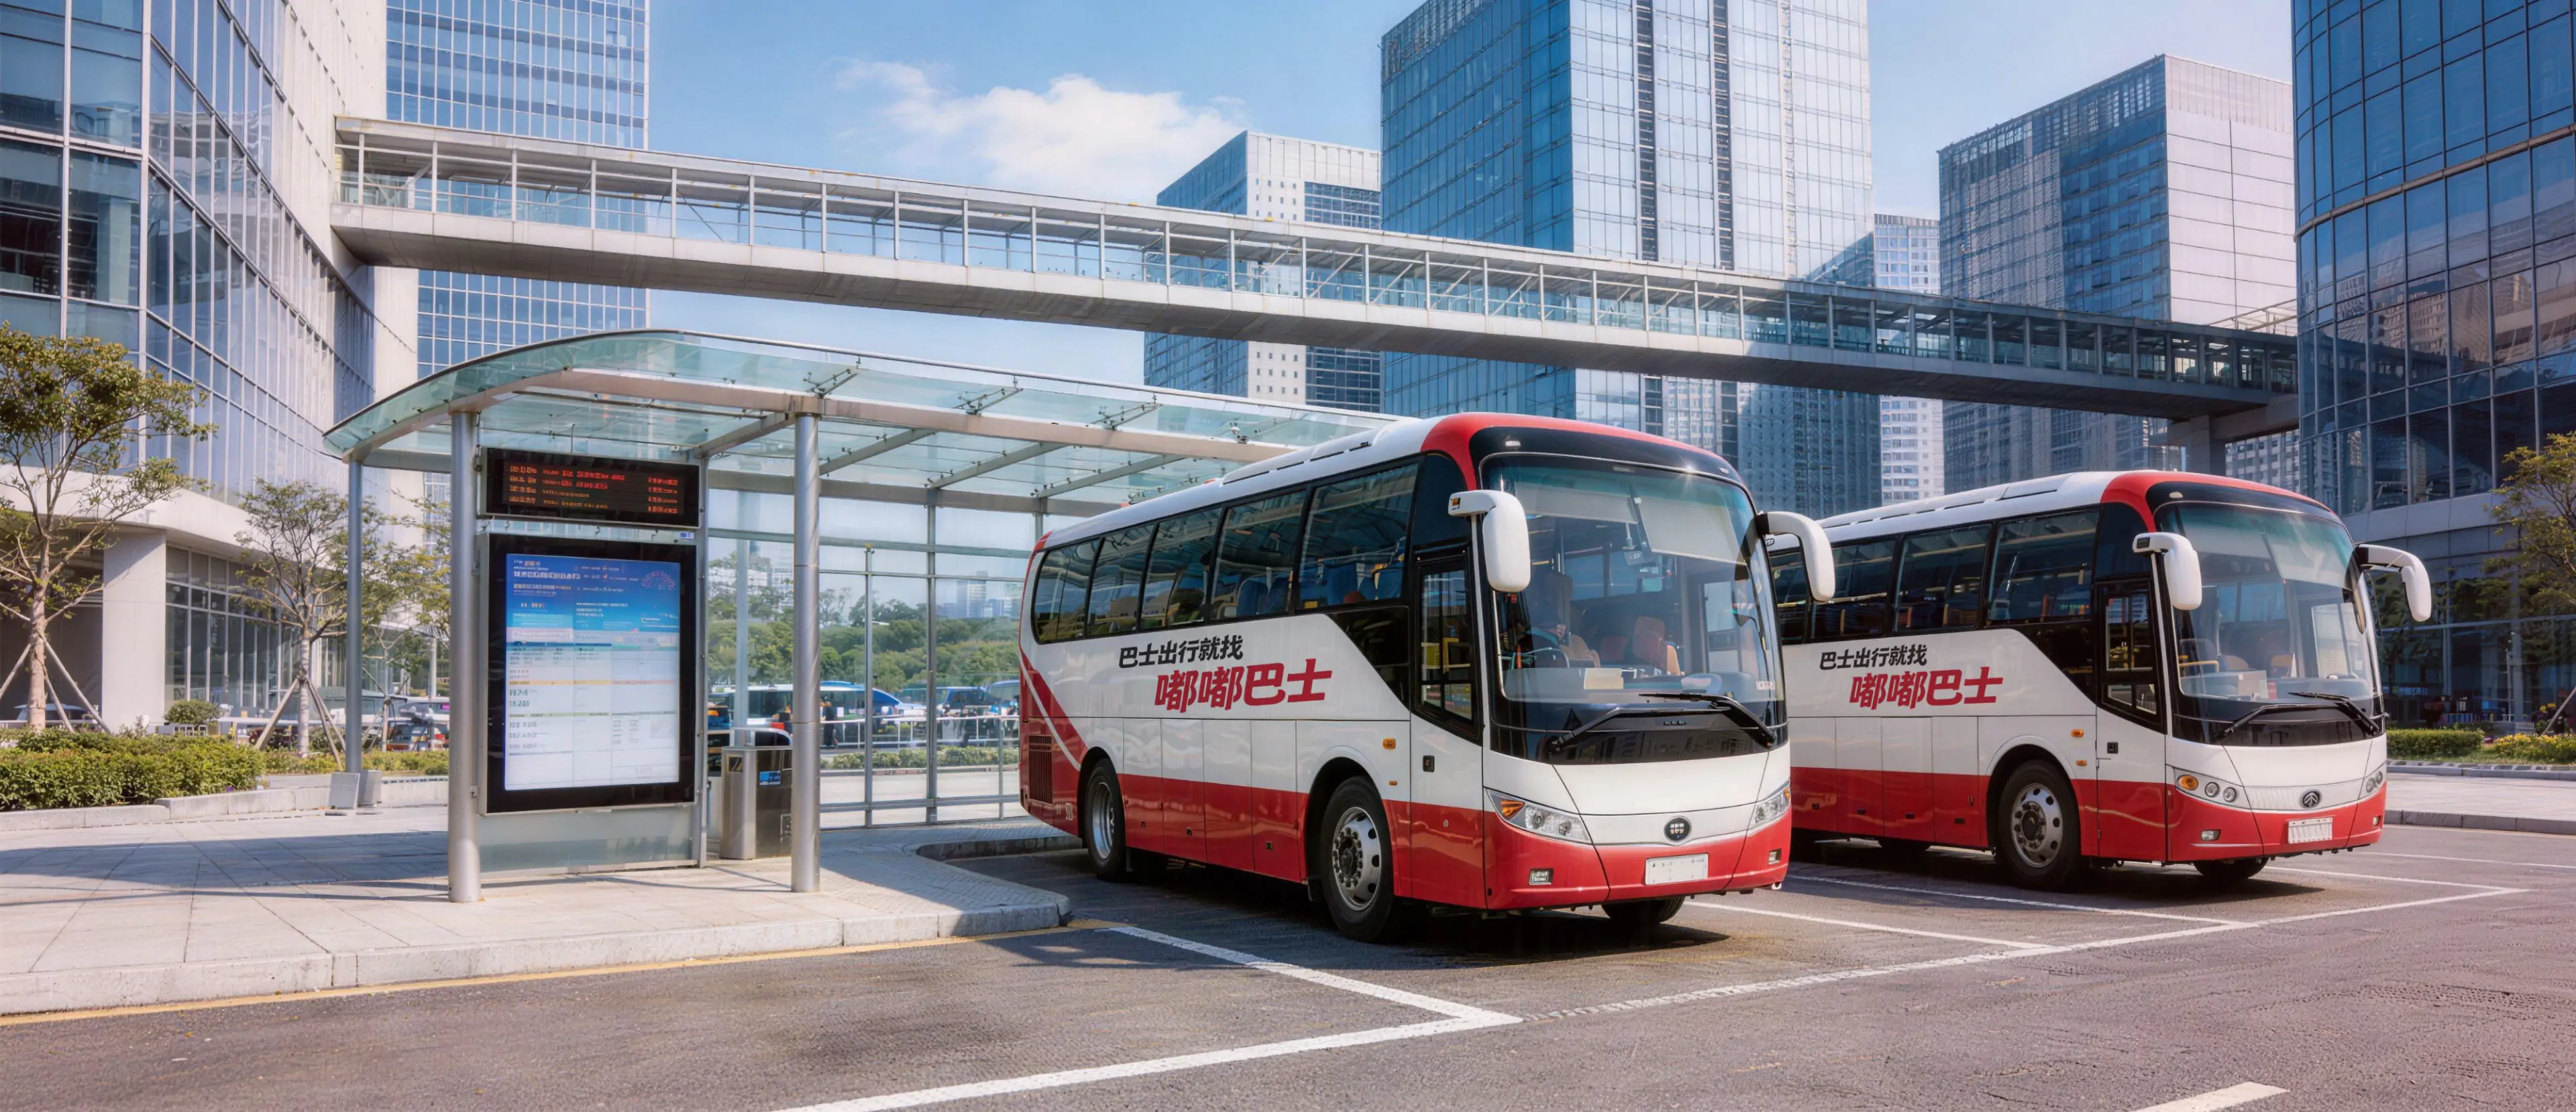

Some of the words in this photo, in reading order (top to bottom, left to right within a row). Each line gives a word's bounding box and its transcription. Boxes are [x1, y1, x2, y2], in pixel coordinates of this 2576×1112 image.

[1118, 634, 1243, 669] 巴士出行就找
[1819, 644, 1927, 671] 巴士出行就找
[1155, 658, 1332, 713] 嘟嘟巴士
[1849, 666, 2004, 710] 嘟嘟巴士
